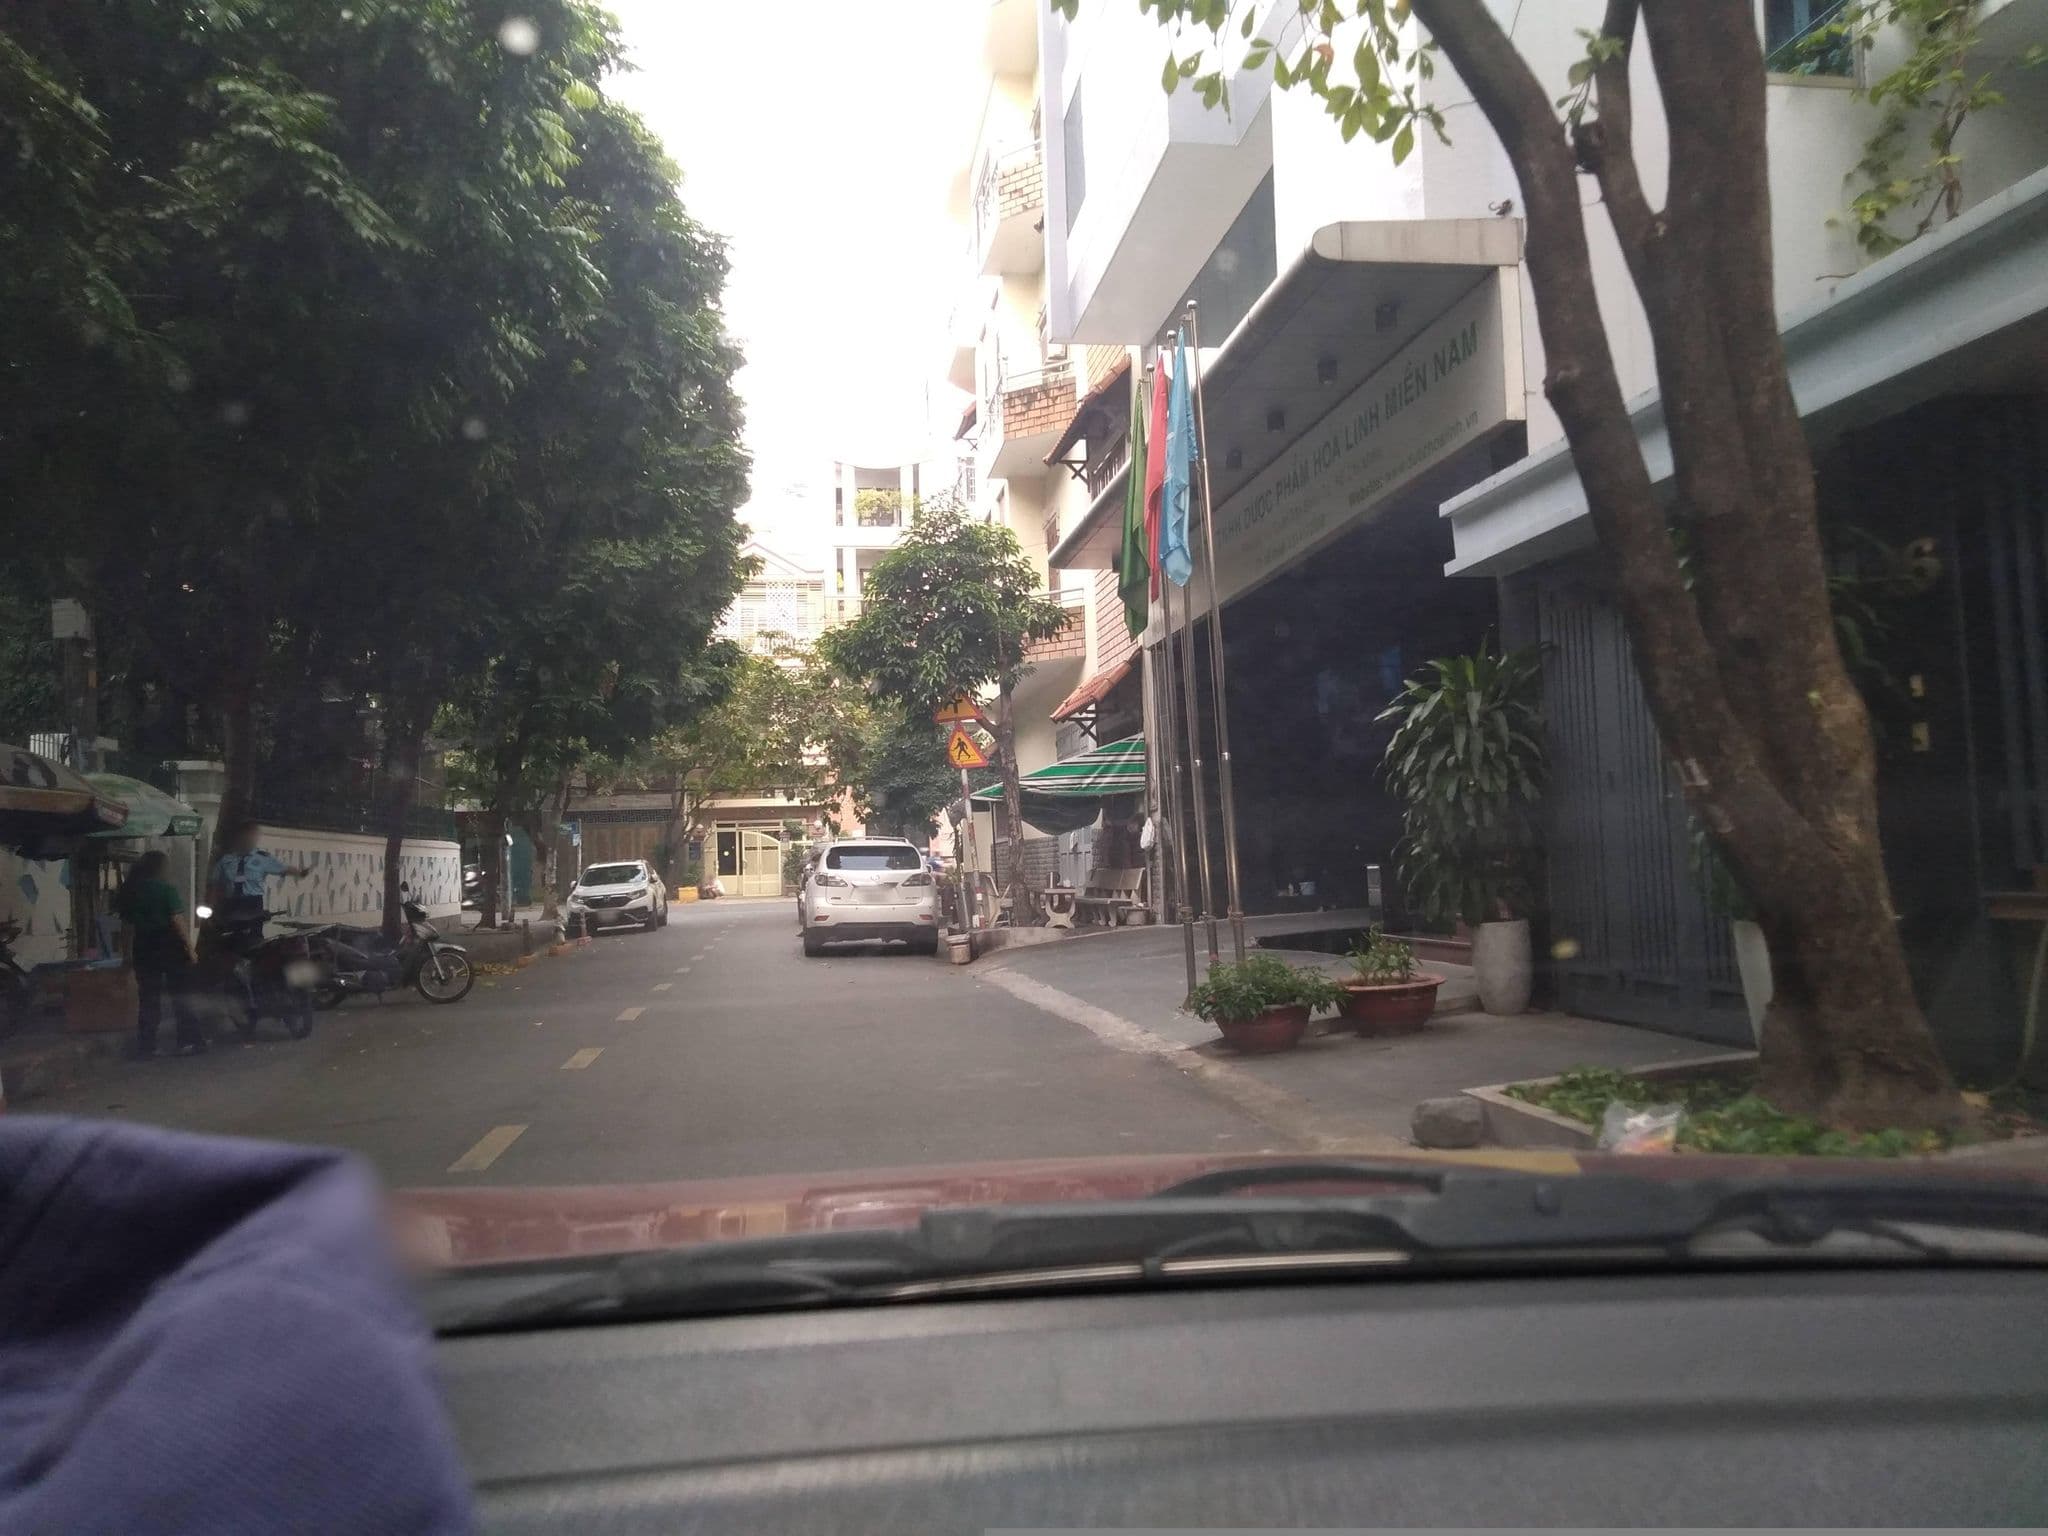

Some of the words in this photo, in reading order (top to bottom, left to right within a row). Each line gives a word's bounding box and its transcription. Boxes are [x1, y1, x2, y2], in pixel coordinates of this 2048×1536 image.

[1313, 436, 1342, 479] HOA
[1345, 401, 1380, 450] LINH
[1433, 320, 1478, 383] NAM
